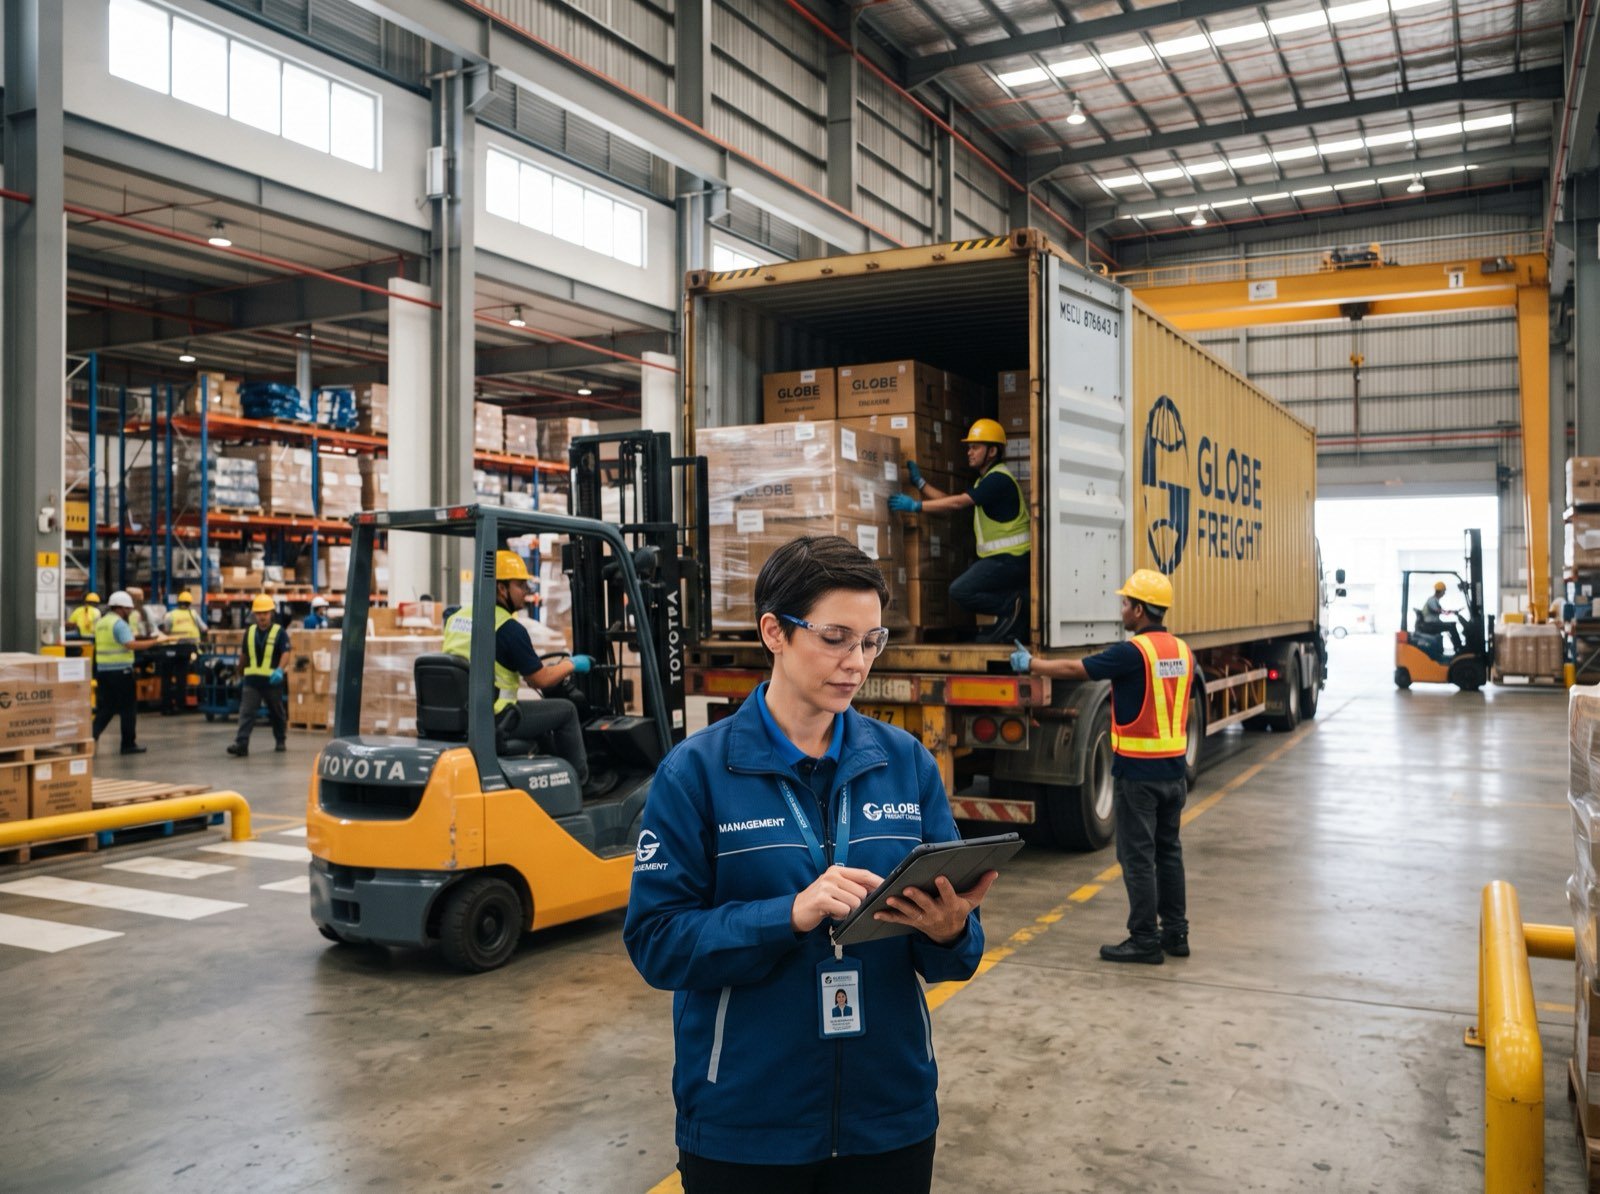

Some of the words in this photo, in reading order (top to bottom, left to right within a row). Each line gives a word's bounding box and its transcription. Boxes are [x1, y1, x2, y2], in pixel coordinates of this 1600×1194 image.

[1060, 301, 1081, 325] MSCU
[1084, 310, 1111, 335] 876643
[777, 385, 820, 399] GLOBE
[852, 376, 897, 390] GLOBE
[1197, 435, 1262, 511] GLOBE
[1197, 509, 1262, 561] FREIGHT
[667, 590, 681, 684] TOYOTA
[15, 689, 54, 701] GLOBE
[323, 755, 406, 781] TOYOTA
[882, 802, 921, 816] GLOBE
[719, 817, 785, 833] MANAGEMENT
